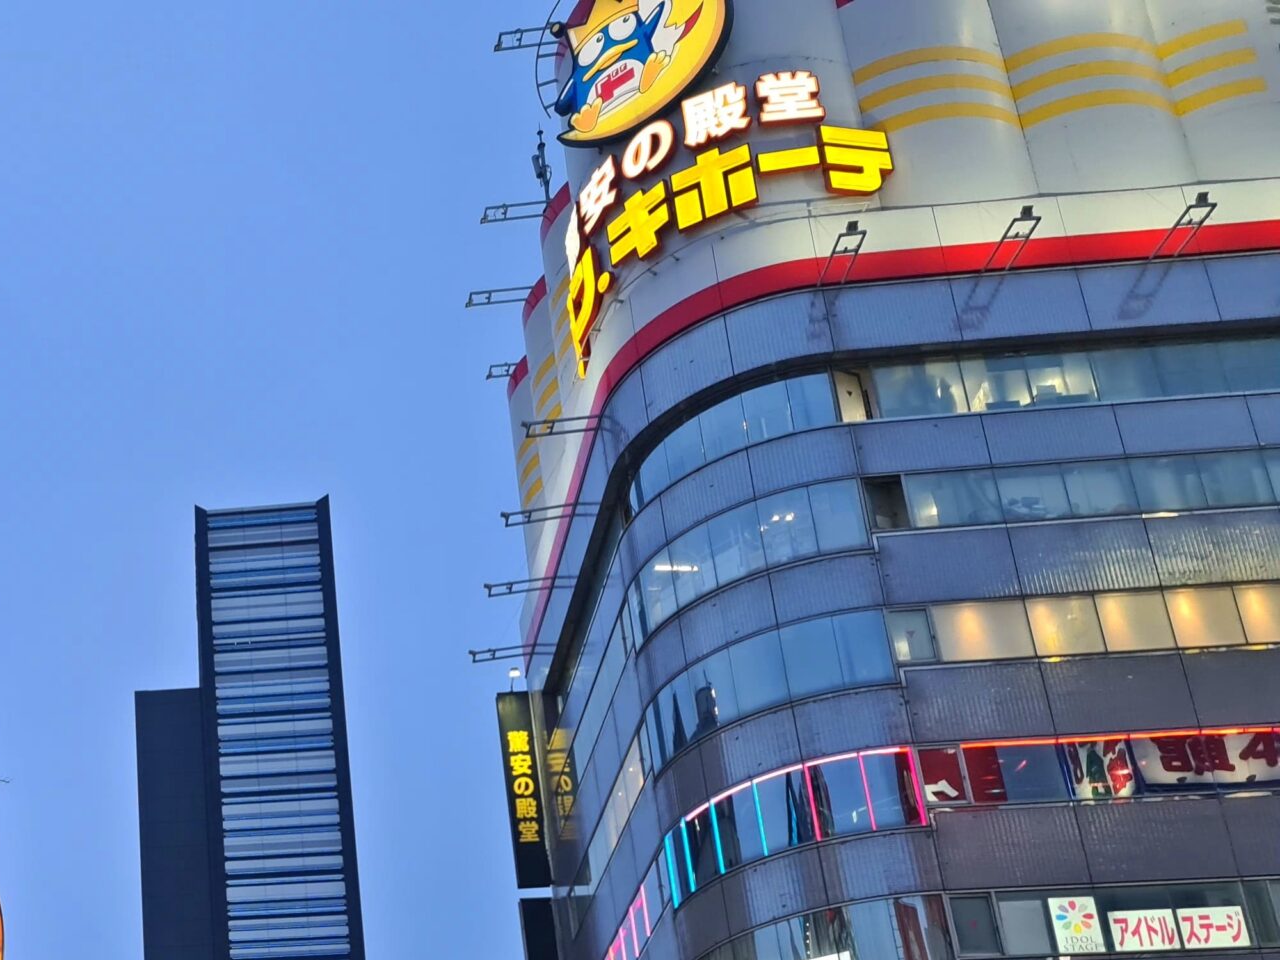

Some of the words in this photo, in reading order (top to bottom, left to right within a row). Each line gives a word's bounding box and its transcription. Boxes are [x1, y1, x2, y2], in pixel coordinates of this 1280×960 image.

[565, 70, 825, 281] 安の殿堂
[507, 730, 540, 843] 驚安の殿堂
[1064, 935, 1097, 945] IDOL
[1113, 916, 1177, 948] アイドル
[1181, 910, 1243, 945] ステージ
